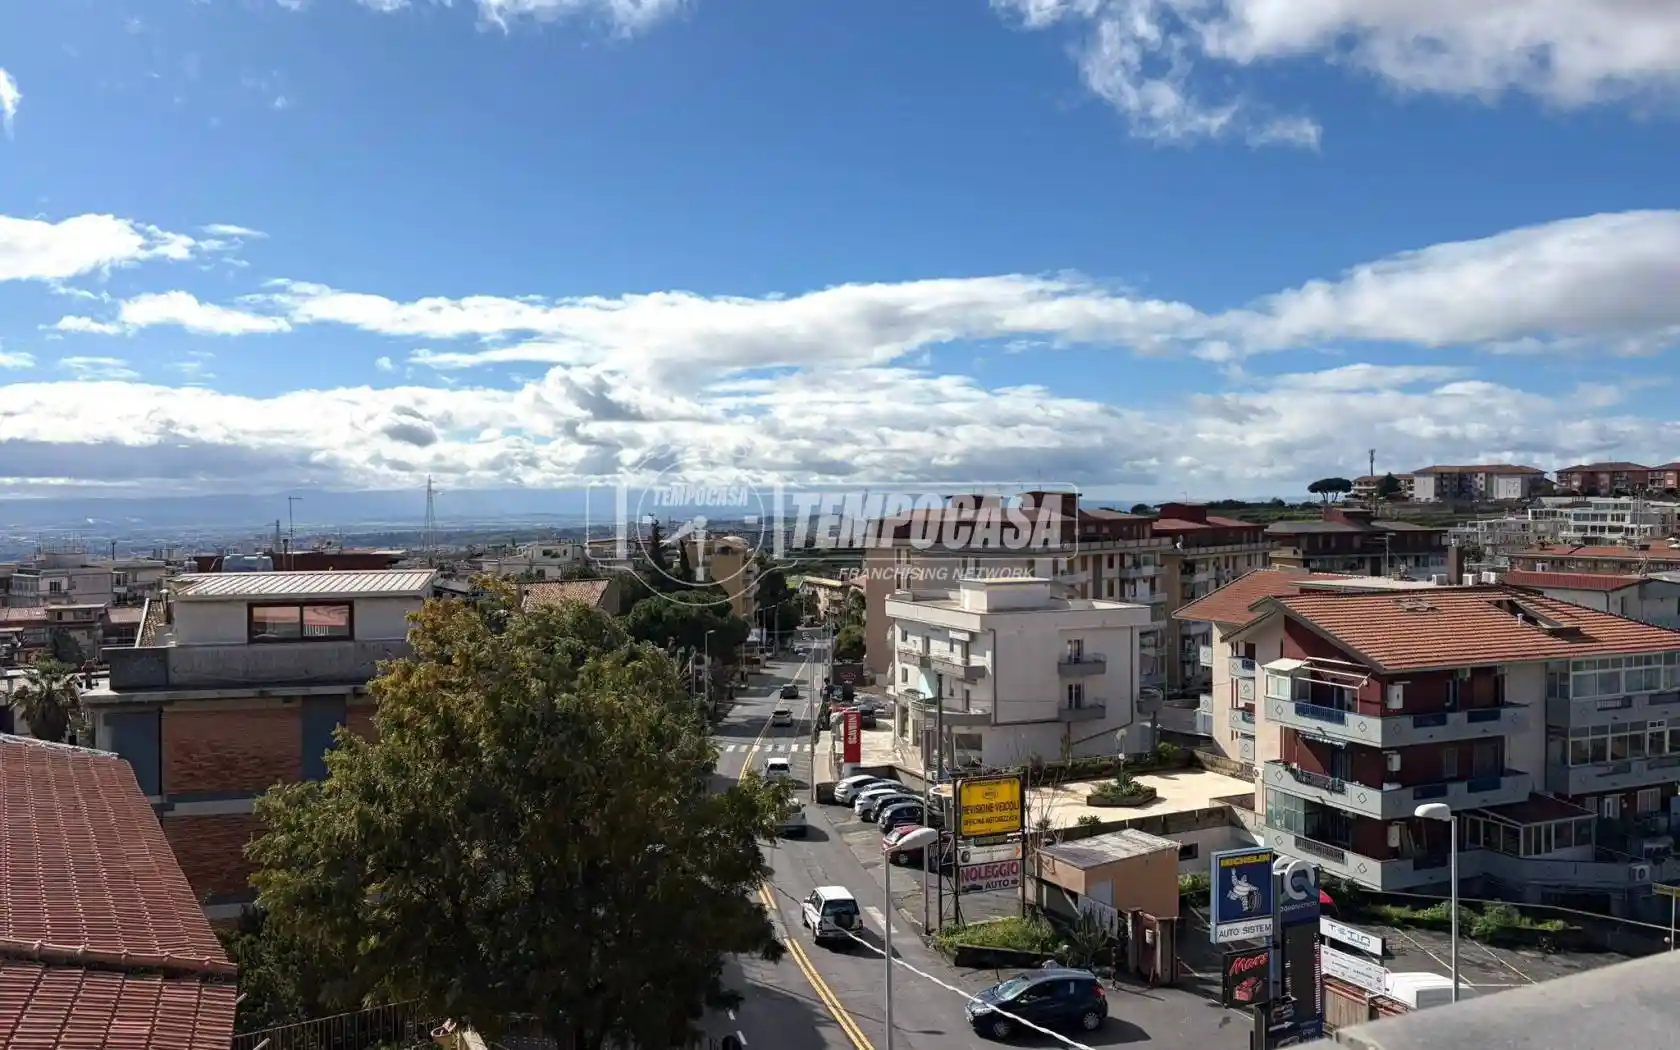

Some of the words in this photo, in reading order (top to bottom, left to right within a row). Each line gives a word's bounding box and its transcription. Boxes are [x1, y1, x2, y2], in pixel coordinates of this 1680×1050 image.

[960, 862, 1019, 884] NOLEGGIO
[985, 879, 1010, 889] AUTO
[1219, 927, 1240, 938] AUTO
[1242, 924, 1272, 935] SISTEM
